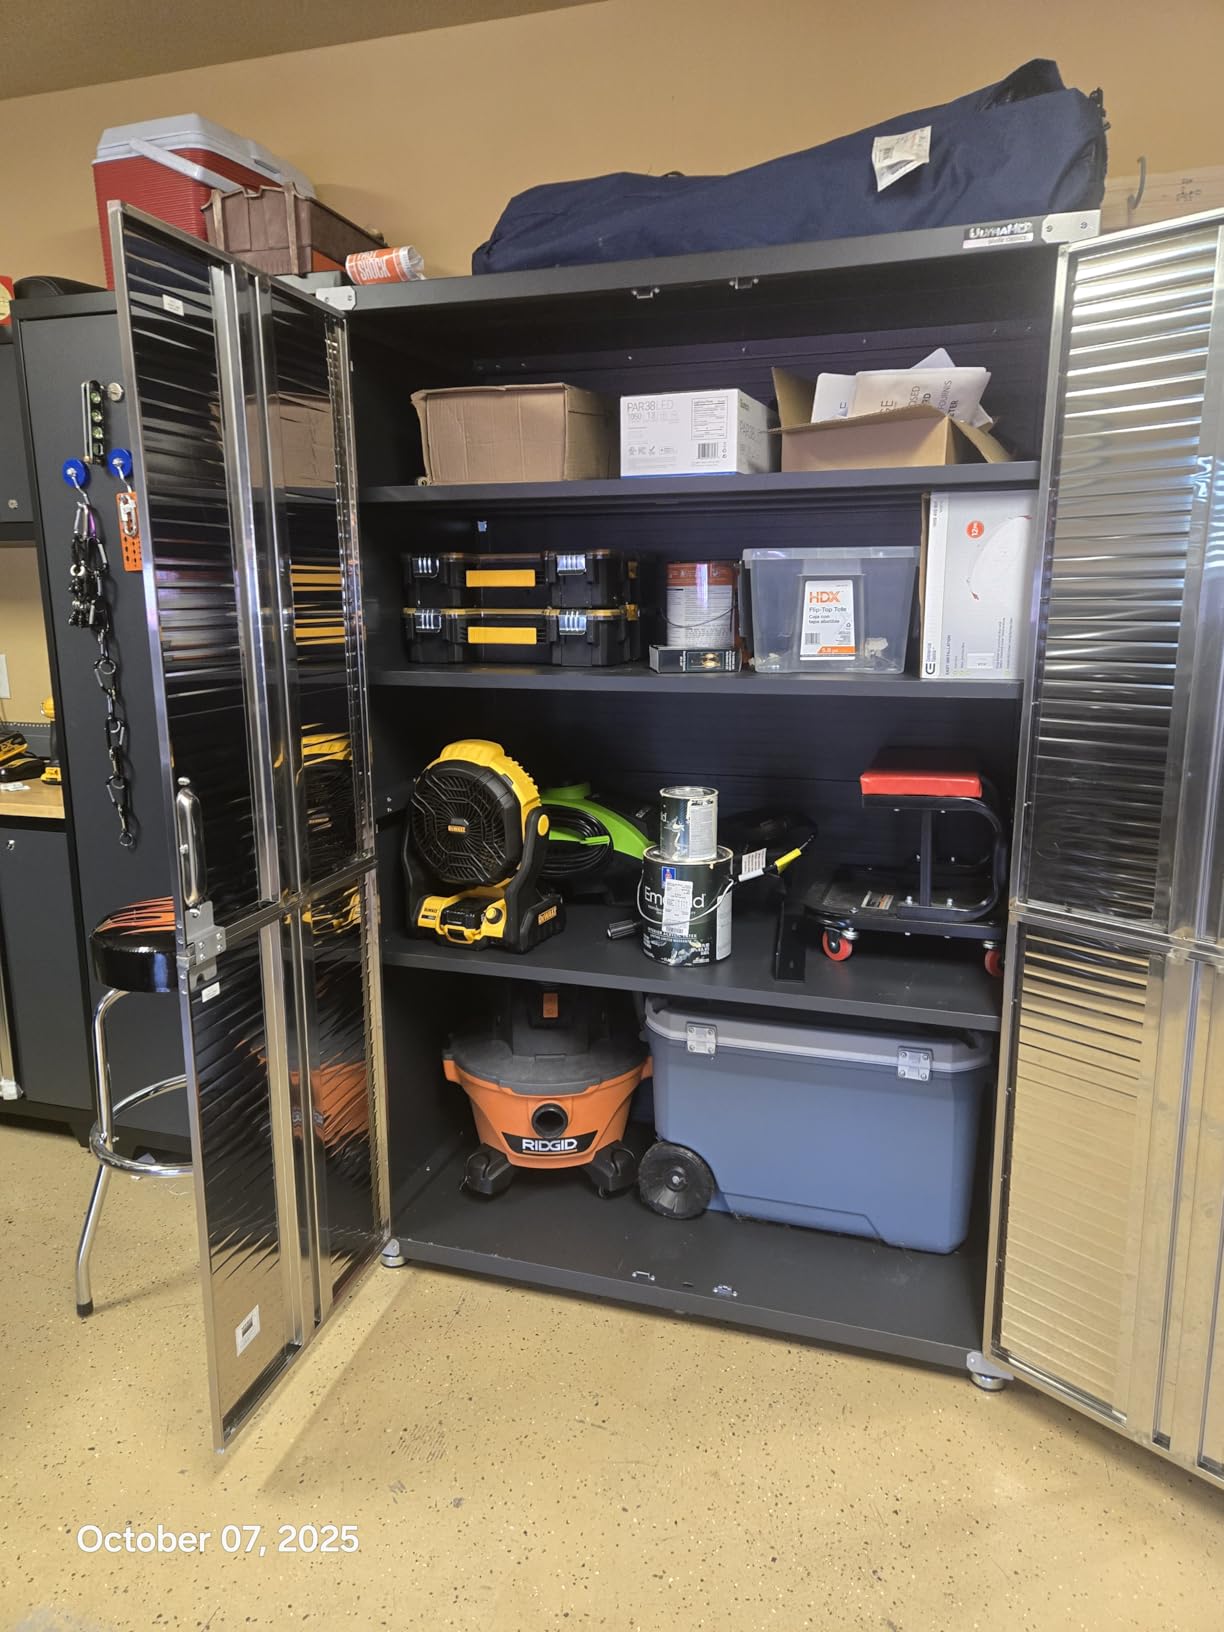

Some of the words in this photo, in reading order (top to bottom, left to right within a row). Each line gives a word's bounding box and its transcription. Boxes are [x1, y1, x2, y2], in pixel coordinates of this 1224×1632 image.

[357, 257, 391, 281] SHOCK
[626, 400, 656, 413] PAR38
[809, 591, 841, 603] HDX
[522, 1138, 578, 1152] RIDGID
